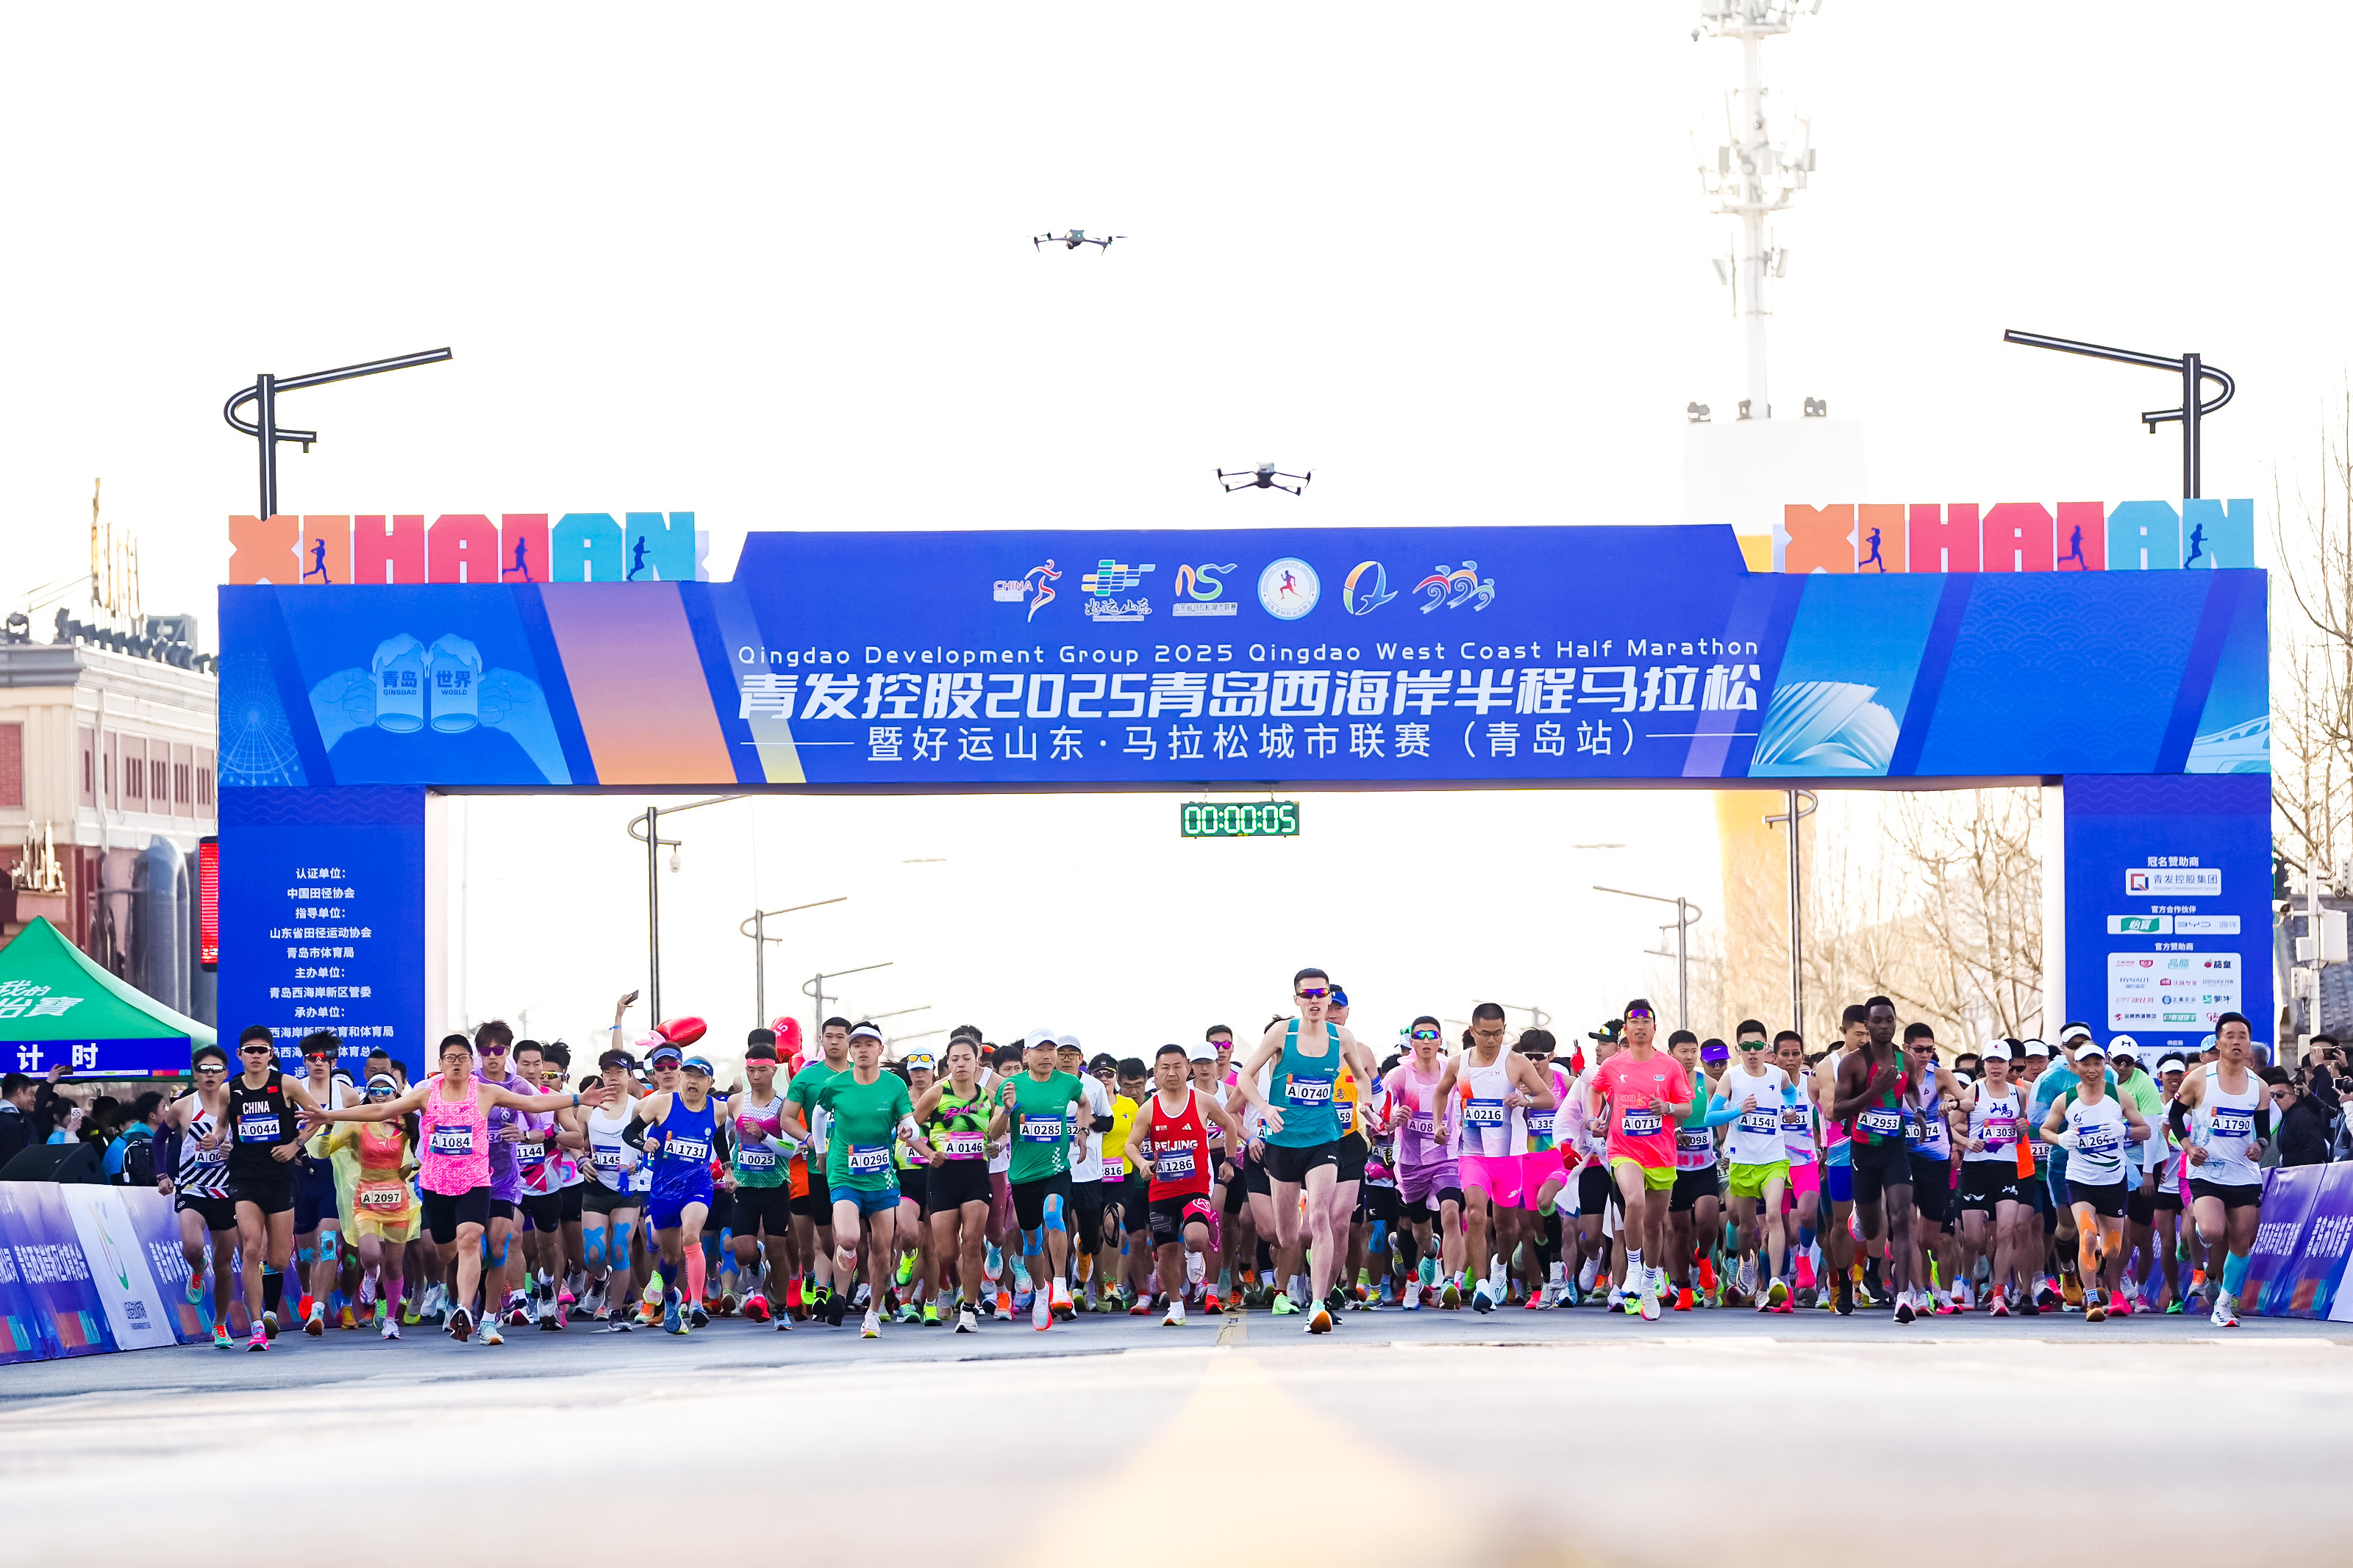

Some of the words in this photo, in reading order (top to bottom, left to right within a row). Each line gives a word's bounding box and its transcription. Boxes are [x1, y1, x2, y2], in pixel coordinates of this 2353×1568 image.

[1785, 498, 2254, 573] XIHAIAN
[229, 512, 695, 584] XIHAIAN
[993, 580, 1033, 592] CHINA
[1085, 598, 1152, 615] 好运山东
[738, 646, 850, 667] Qingdao
[865, 645, 1043, 666] Development
[1060, 645, 1138, 666] Group
[1154, 645, 1232, 662] 2025
[1249, 642, 1360, 664] Qingdao
[1377, 642, 1445, 659] West
[1460, 641, 1540, 659] Coast
[1557, 640, 1613, 658] Half
[1627, 639, 1758, 656] Marathon
[382, 670, 418, 688] 青岛
[435, 670, 472, 688] 世界
[382, 688, 417, 696] QINGDAO
[441, 688, 468, 696] WORLD
[738, 664, 1760, 720] 青发控股2025青岛西海岸半程马拉松
[1185, 805, 1296, 834] 00:00:05
[2147, 856, 2199, 867] 冠名赞助商
[296, 867, 346, 879] 认证单位：
[2154, 874, 2218, 884] 青发控股集团
[287, 887, 354, 899] 中国田径协会
[295, 907, 346, 919] 指导单位：
[2151, 905, 2196, 914] 官方合作伙伴
[270, 927, 372, 939] 山东省田径运动协会
[2154, 942, 2194, 951] 官方赞助商
[287, 947, 354, 959] 青岛市体育局
[295, 967, 345, 978] 主办单位：
[0, 980, 51, 997] 我的
[269, 986, 371, 998] 青岛西海岸新区管委
[295, 1006, 345, 1018] 承办单位：
[1301, 1088, 1329, 1098] 0740
[243, 1100, 270, 1114] CHINA
[1474, 1110, 1502, 1120] 0216
[1538, 1120, 1554, 1128] 335
[1635, 1118, 1660, 1129] 0717
[1752, 1117, 1775, 1128] 1541
[1872, 1117, 1897, 1128] 2953
[2224, 1120, 2250, 1130] 1790
[250, 1124, 278, 1134] 0044
[1034, 1125, 1060, 1135] 0285
[1913, 1126, 1939, 1136] 074
[1996, 1128, 2016, 1136] 3033
[442, 1136, 471, 1147] 1084
[1154, 1139, 1199, 1151] BEIJING
[517, 1147, 543, 1157] 1144
[678, 1145, 704, 1157] 1731
[958, 1142, 982, 1153] 0146
[603, 1156, 621, 1164] 145
[748, 1155, 774, 1164] 0025
[863, 1153, 888, 1166] 0296
[1102, 1167, 1122, 1175] 816
[1166, 1159, 1193, 1172] 1286
[374, 1193, 399, 1203] 2097
